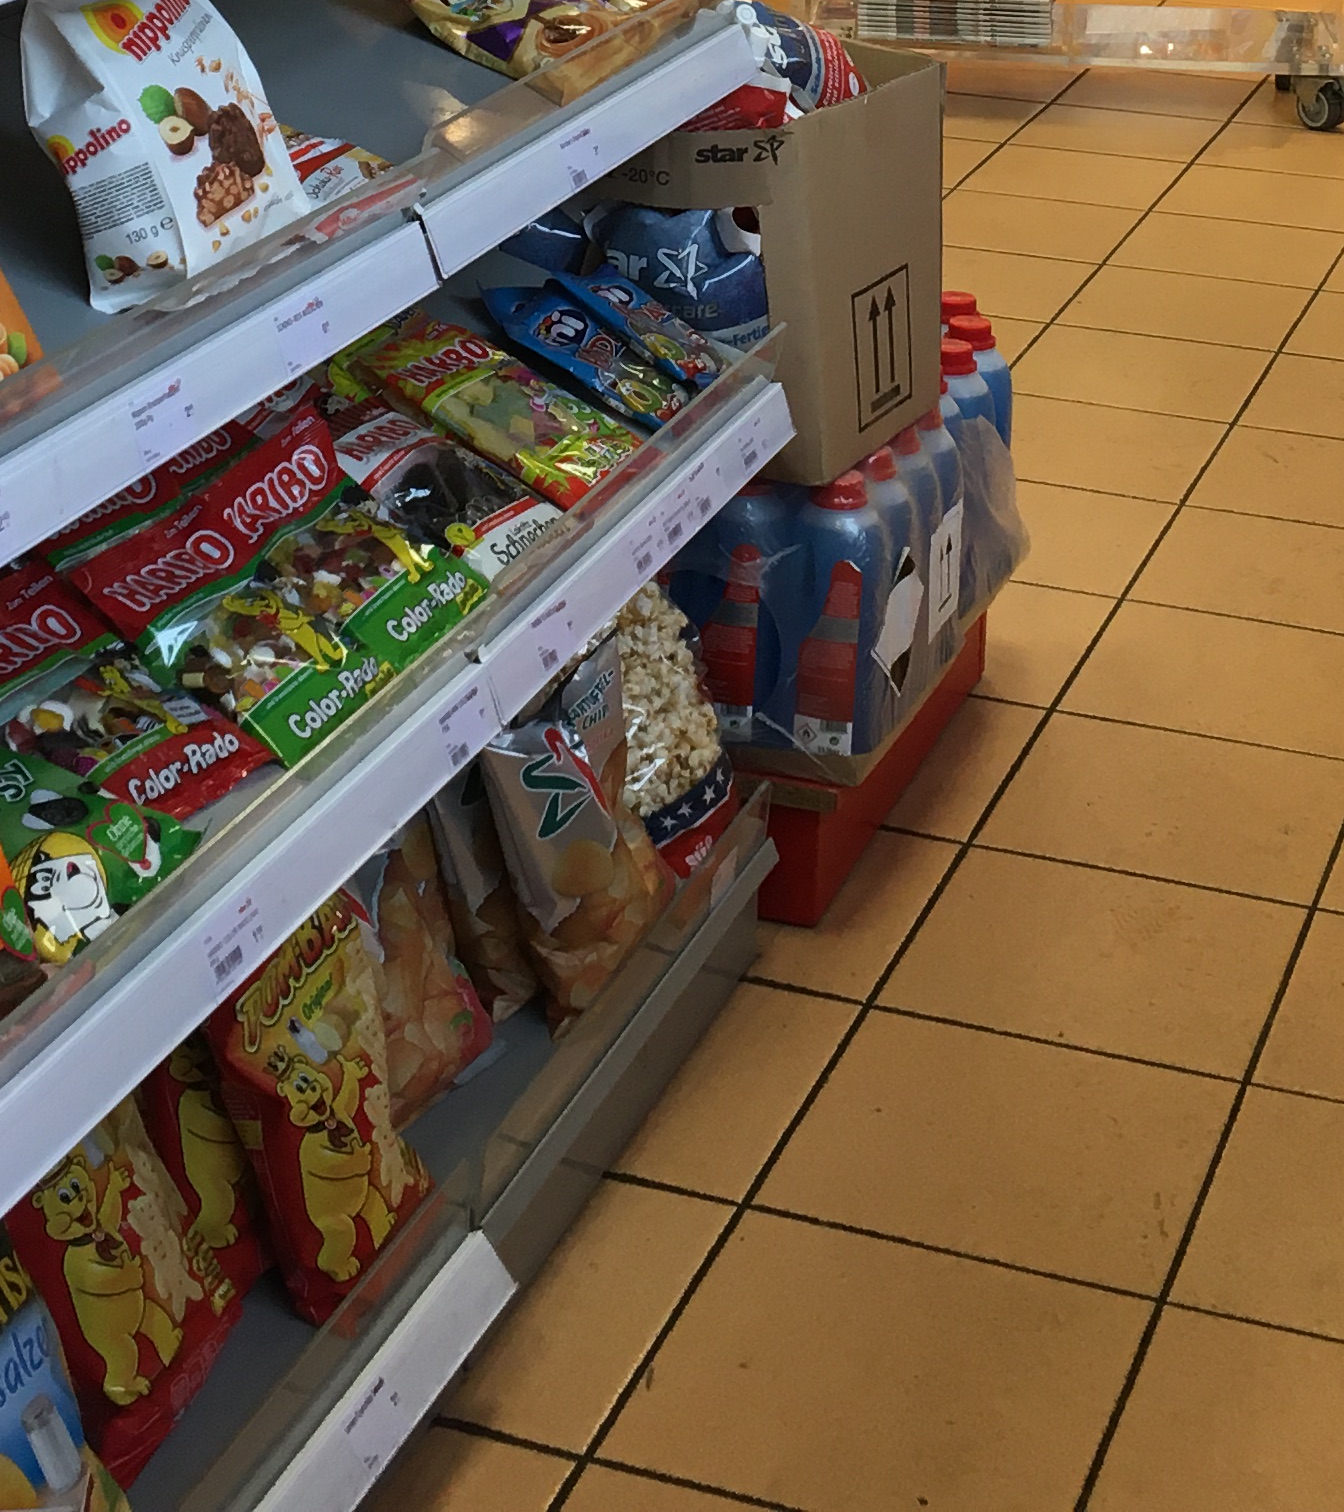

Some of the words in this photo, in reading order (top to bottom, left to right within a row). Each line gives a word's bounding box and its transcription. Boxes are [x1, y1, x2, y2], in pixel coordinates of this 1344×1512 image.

[695, 144, 748, 163] star
[125, 226, 148, 245] 130
[404, 336, 492, 388] HARIBO
[102, 530, 235, 613] HARIBO
[384, 568, 467, 644] Color-Rado
[287, 654, 380, 740] Color-Rado
[127, 729, 240, 805] Color-Rado
